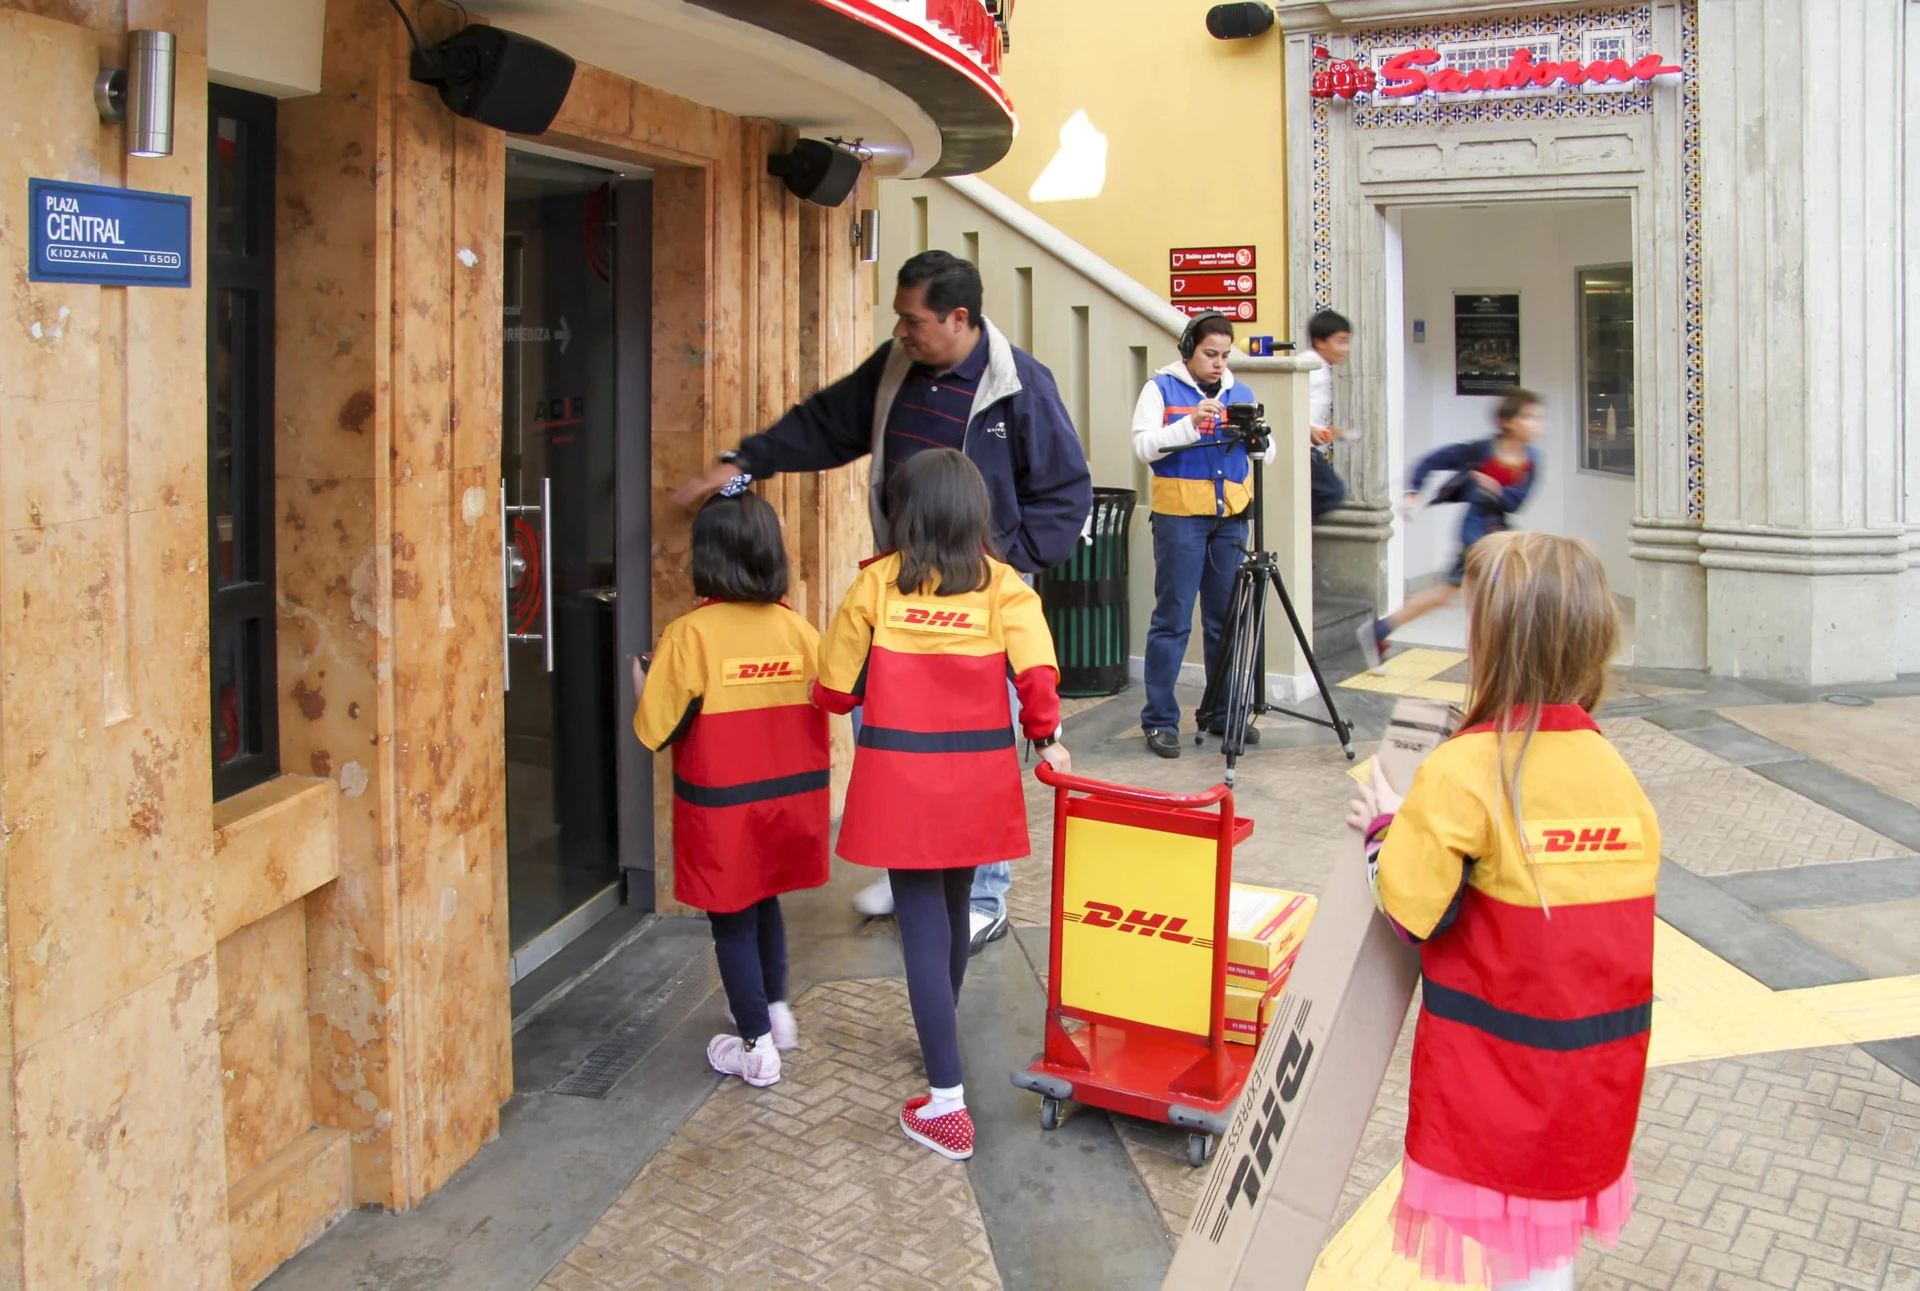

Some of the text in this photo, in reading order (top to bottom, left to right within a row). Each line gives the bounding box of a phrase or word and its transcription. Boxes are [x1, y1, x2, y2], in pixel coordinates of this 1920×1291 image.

[1381, 48, 1682, 96] Sanborns
[46, 196, 79, 213] PLAZA
[47, 213, 125, 244] CENTRAL
[50, 248, 177, 264] KIDZANIA 16506
[503, 327, 550, 341] ORREDIZA
[903, 608, 974, 629] DHL
[737, 661, 794, 679] DHL
[1542, 827, 1628, 852] DHL
[1081, 900, 1195, 944] DHL
[1226, 1028, 1314, 1210] DHL
[1228, 1070, 1263, 1153] EXPRESS
